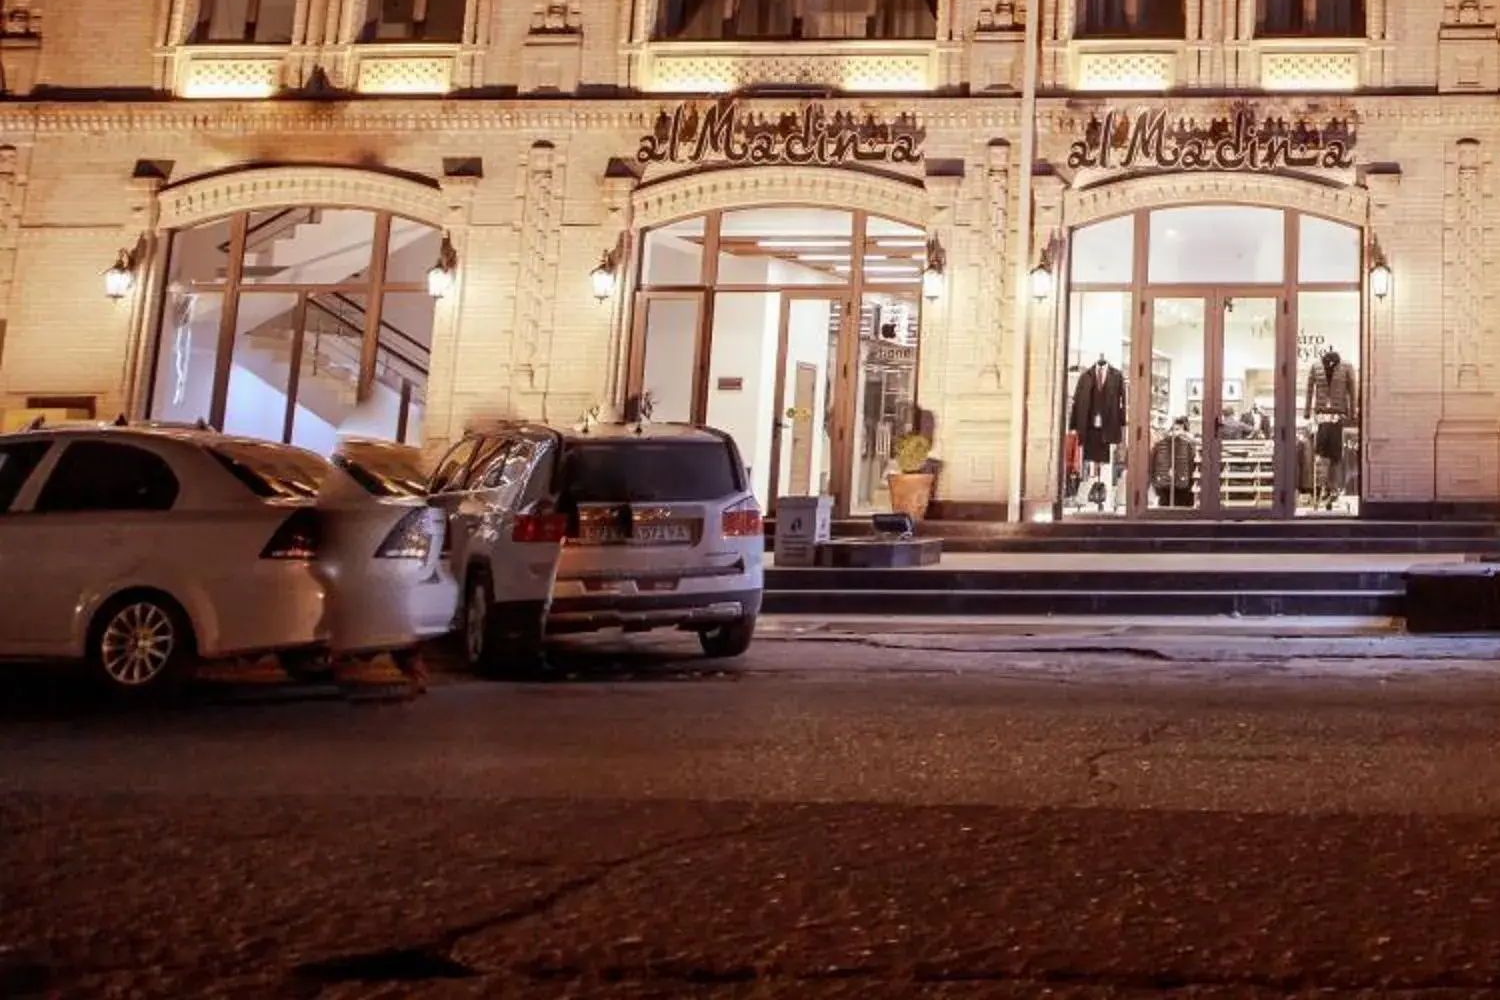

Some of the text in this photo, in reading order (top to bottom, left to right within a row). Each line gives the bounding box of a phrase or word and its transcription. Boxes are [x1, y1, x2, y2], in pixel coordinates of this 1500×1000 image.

[637, 100, 926, 165] al Madina
[1067, 106, 1352, 171] al Madina
